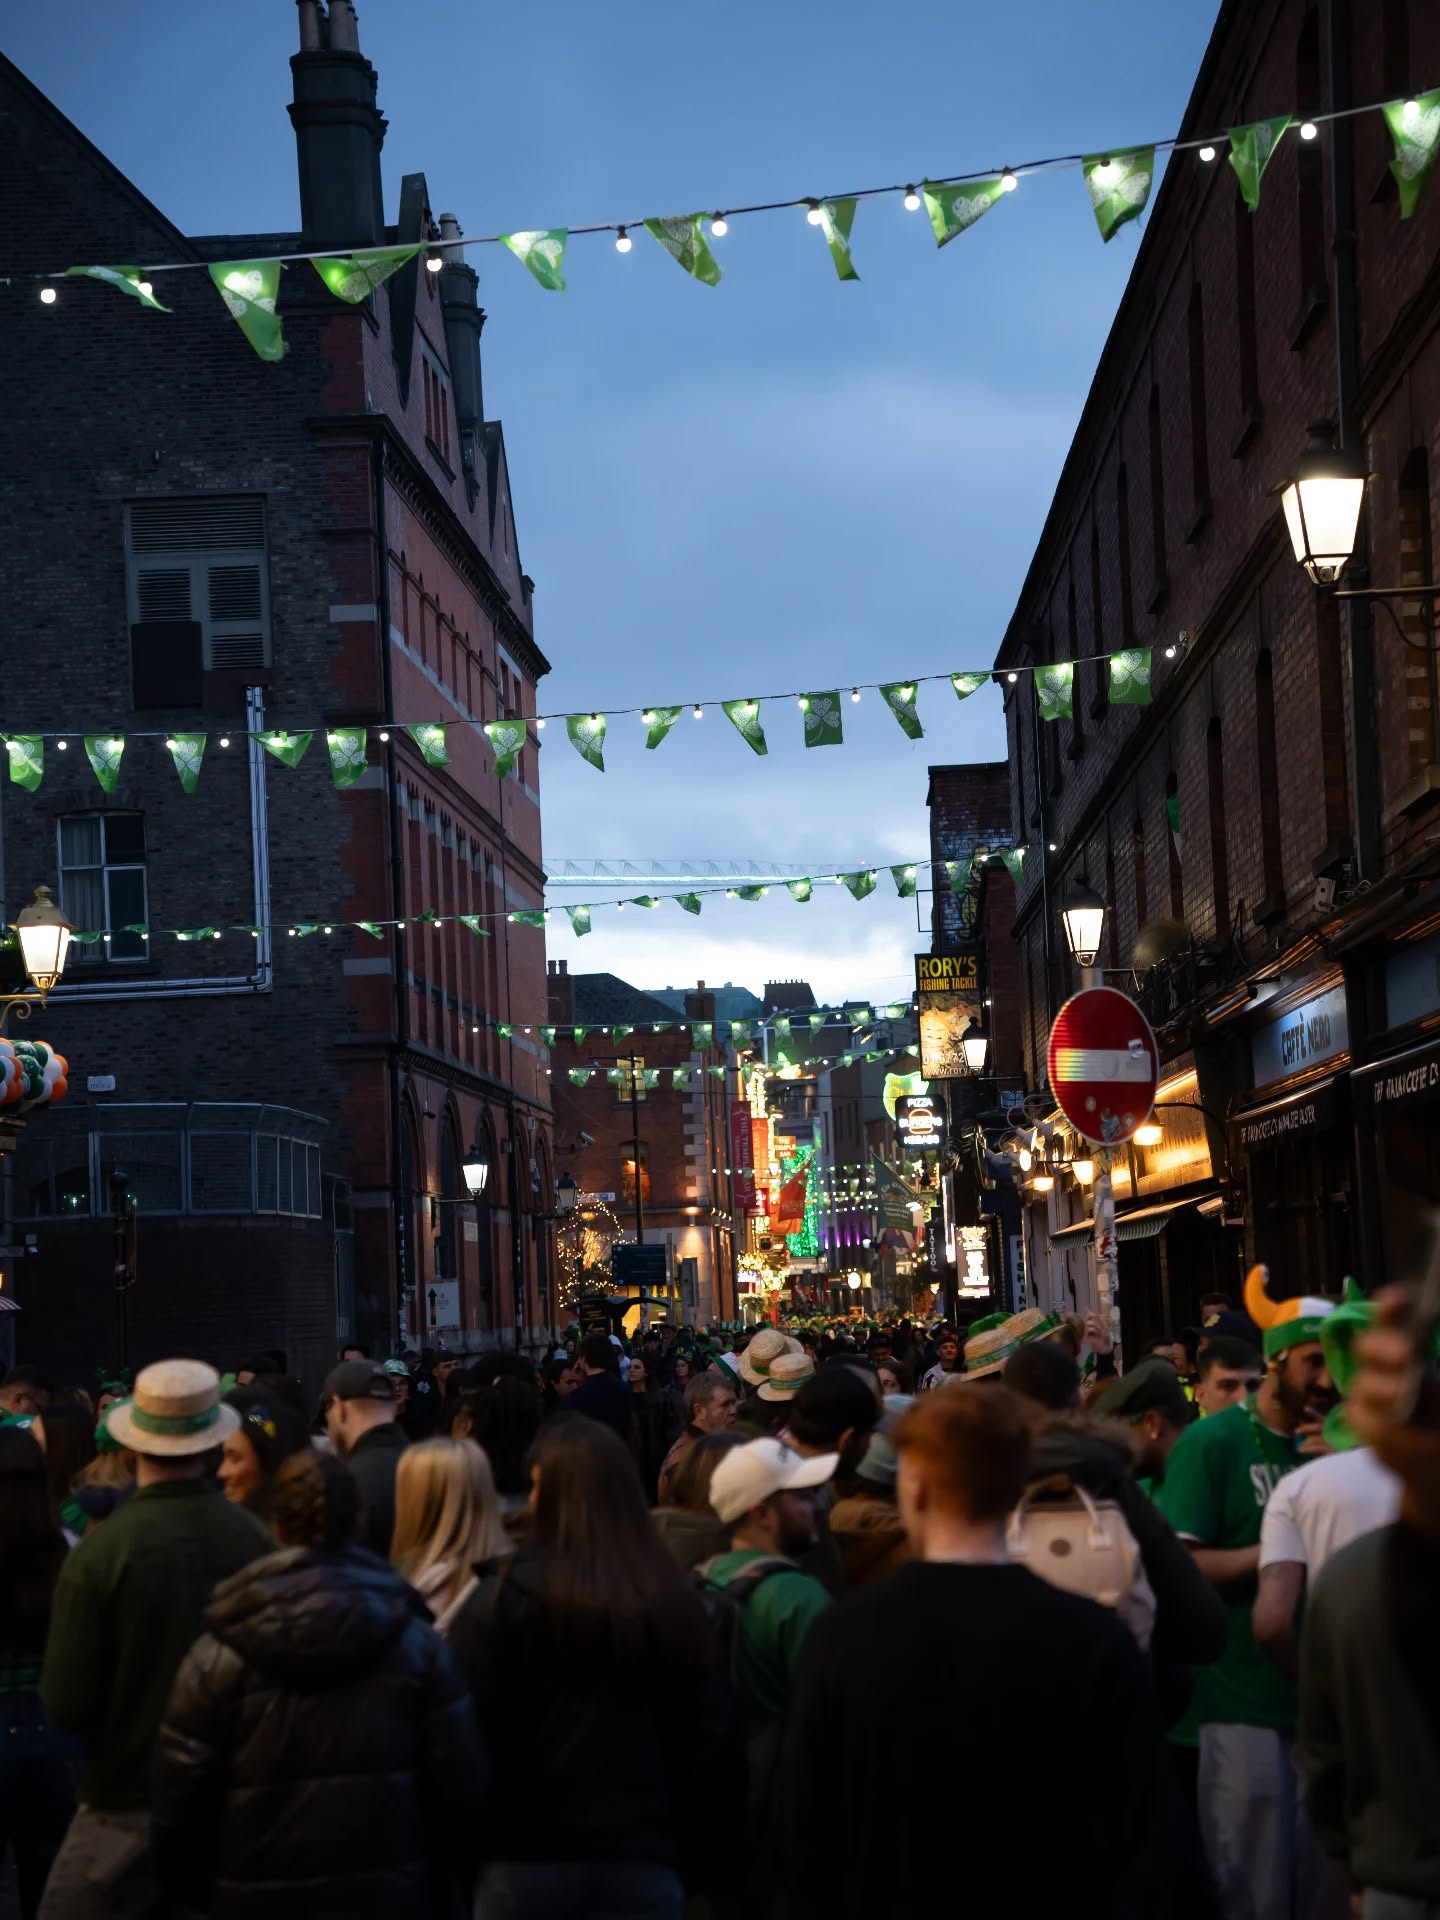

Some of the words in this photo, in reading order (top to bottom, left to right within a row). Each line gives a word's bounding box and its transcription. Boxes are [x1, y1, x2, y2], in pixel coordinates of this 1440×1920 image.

[919, 956, 977, 978] RORY'S
[919, 978, 950, 991] FISHING
[1307, 1013, 1331, 1056] NERO
[907, 1097, 934, 1108] PIZZA
[928, 1228, 938, 1266] TATTOO
